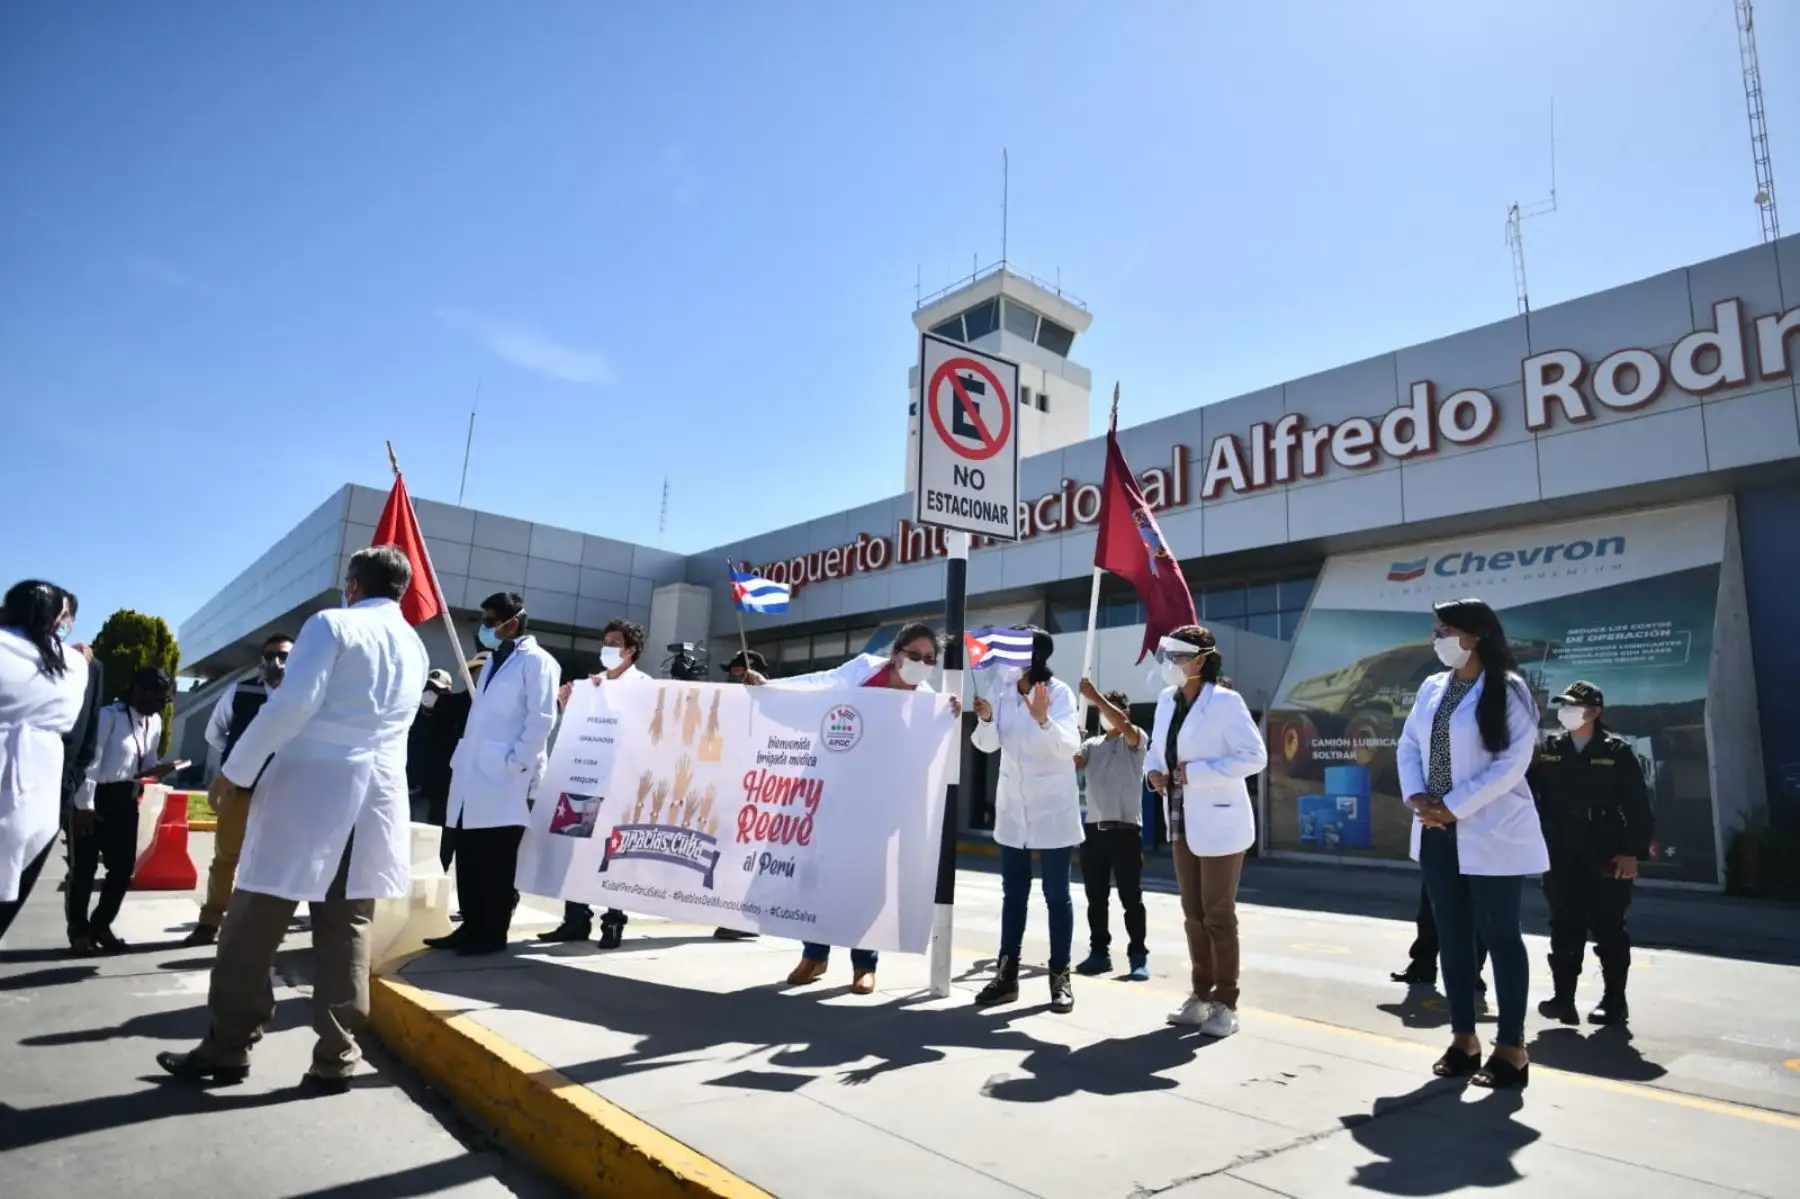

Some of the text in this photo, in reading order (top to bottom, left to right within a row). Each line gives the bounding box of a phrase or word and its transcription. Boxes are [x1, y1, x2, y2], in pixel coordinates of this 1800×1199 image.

[1201, 380, 1500, 500] Alfredo
[953, 464, 986, 490] NO
[927, 489, 1009, 525] ESTACIONAR
[1433, 535, 1626, 577] Chevron
[1353, 738, 1400, 748] LUBRICA
[743, 767, 824, 818] Henry
[736, 803, 814, 847] Reeve
[618, 827, 703, 860] gracias Cuba
[742, 851, 796, 879] al Perú
[770, 904, 817, 924] #CubaSalva
